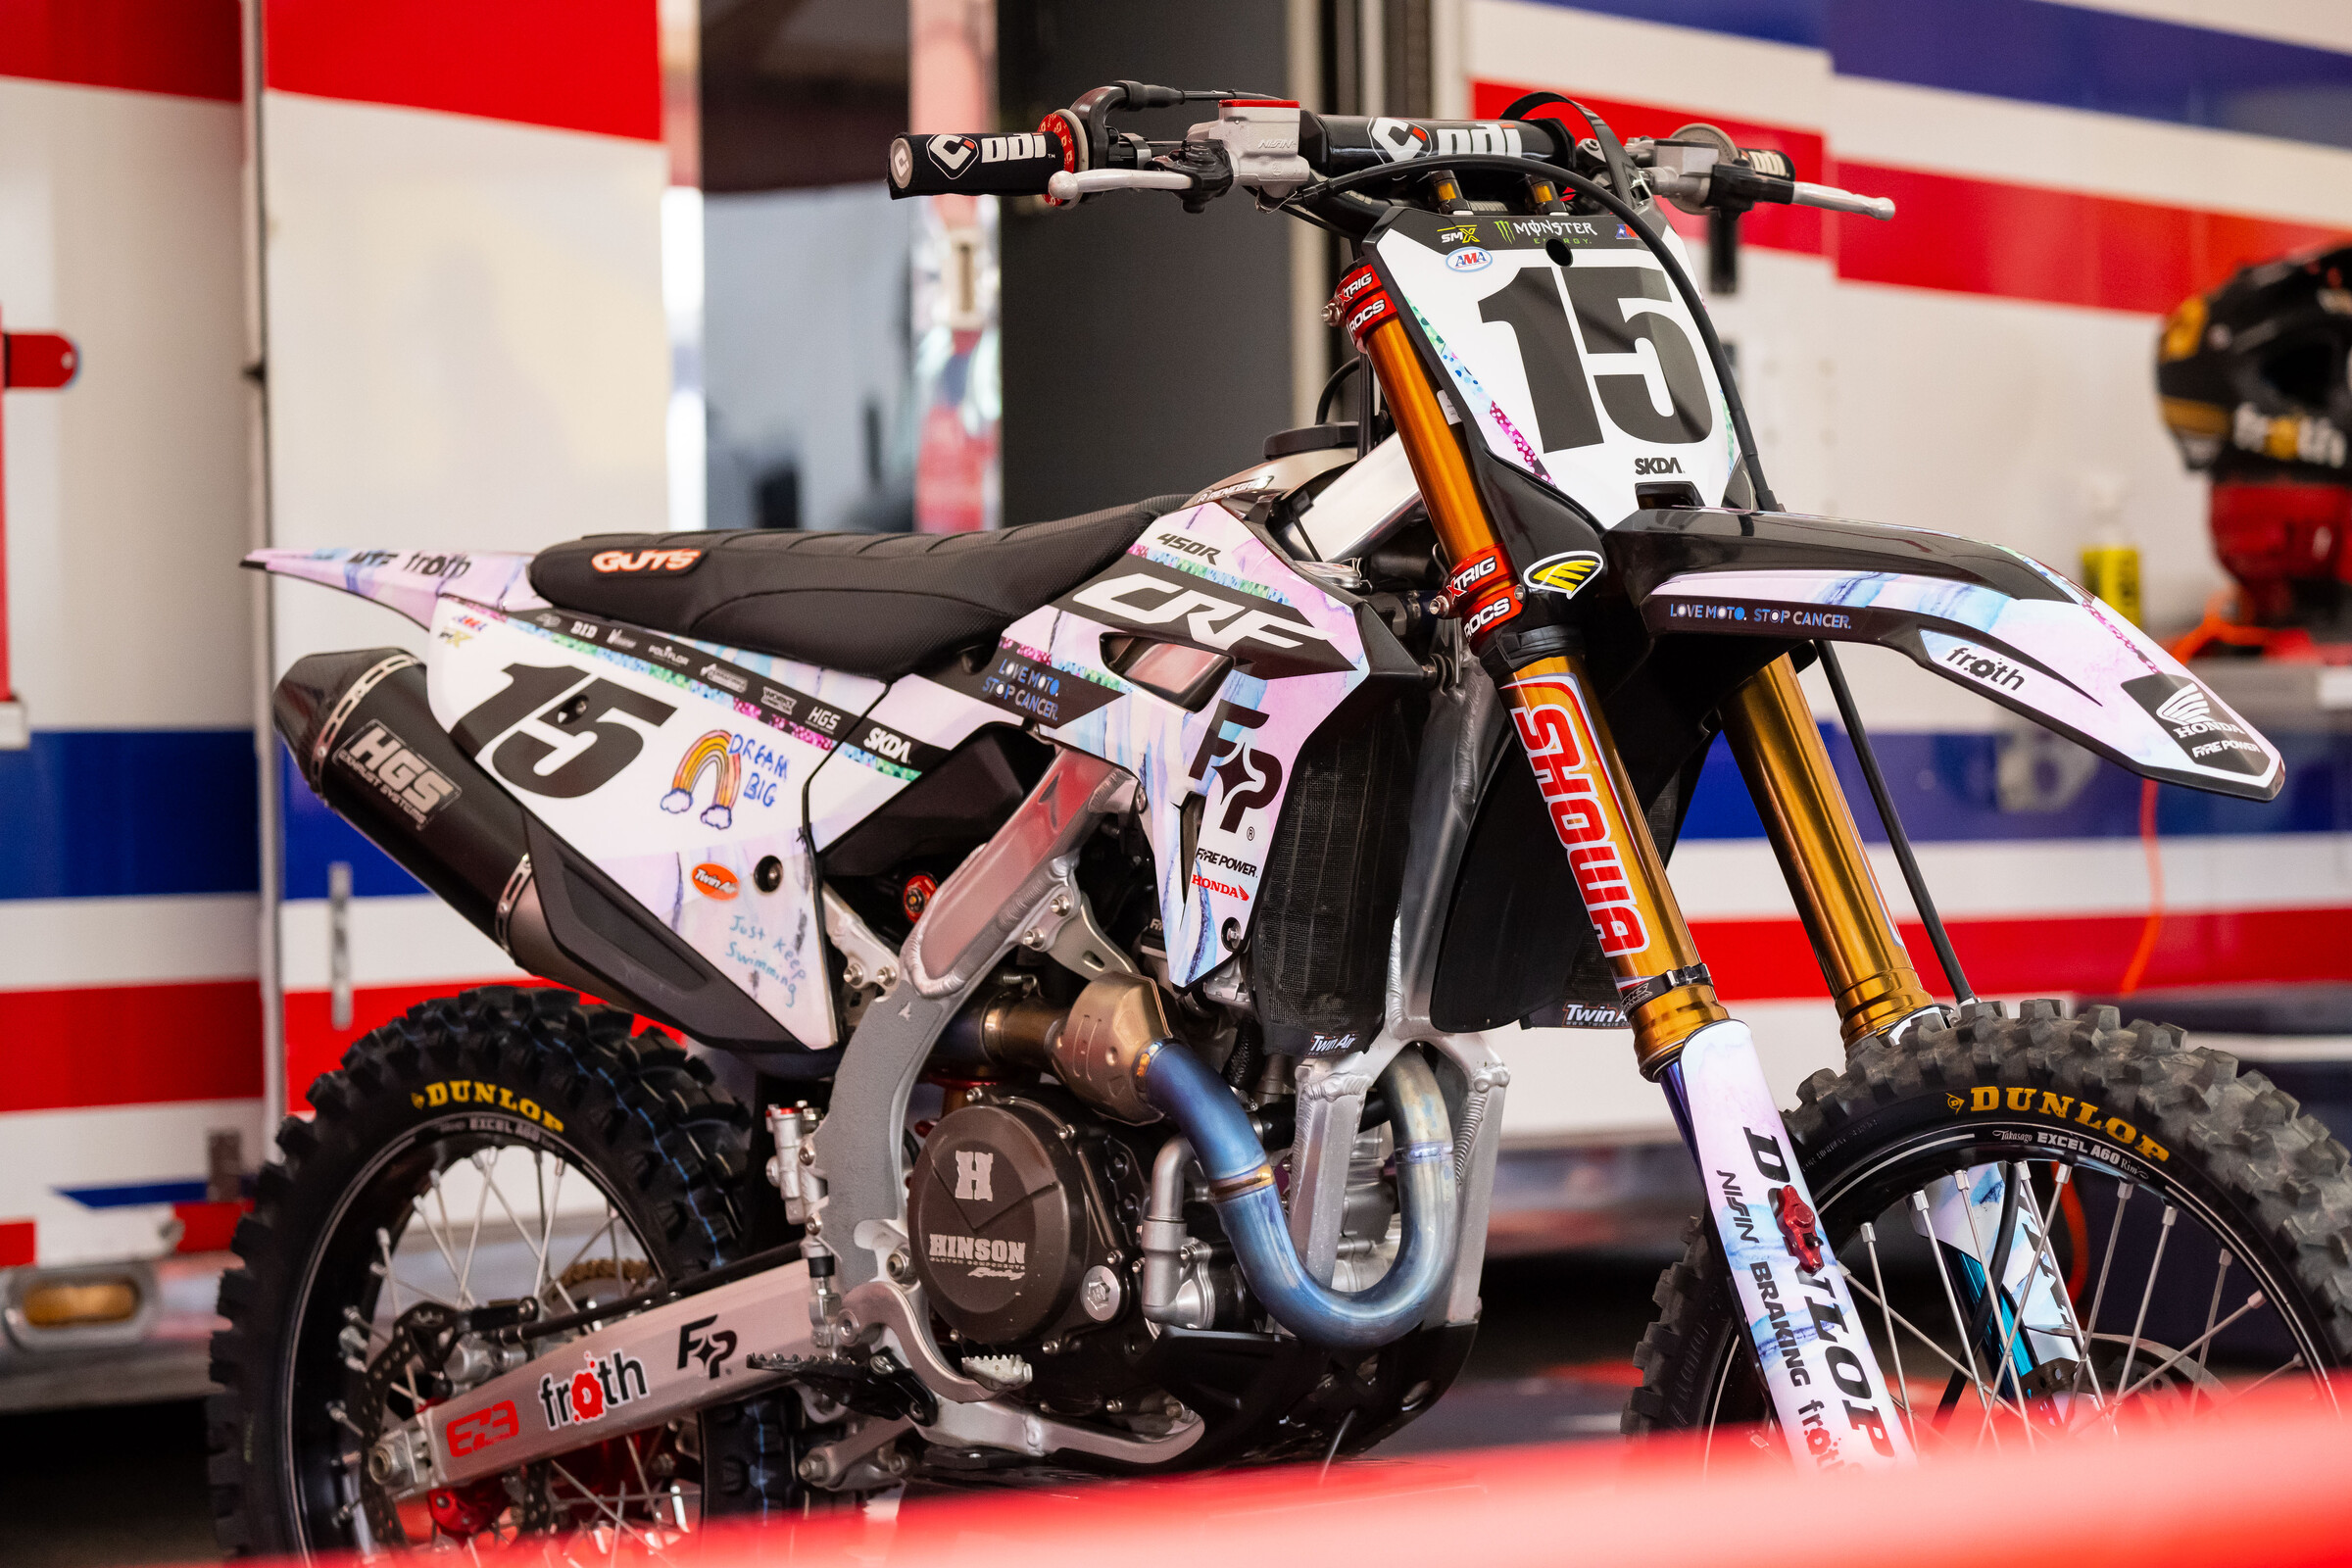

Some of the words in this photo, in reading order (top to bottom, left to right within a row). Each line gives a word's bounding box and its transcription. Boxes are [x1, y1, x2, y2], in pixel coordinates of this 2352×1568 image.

[1454, 252, 1489, 268] AMA
[1337, 272, 1373, 303] XTRIG
[1478, 267, 1712, 454] 15
[1635, 457, 1683, 474] SKDA
[591, 548, 702, 572] GUTS
[1156, 532, 1222, 566] 450R
[1446, 556, 1496, 599] XTRIG
[1072, 572, 1340, 651] CRF
[1463, 597, 1511, 639] ROCS
[1670, 603, 1703, 618] LOVE
[1753, 608, 1791, 624] STOP
[999, 659, 1029, 683] LOVE
[1945, 647, 2025, 692] froth
[982, 676, 1016, 700] STOP
[449, 662, 678, 799] 15
[807, 706, 841, 731] HGS
[2173, 721, 2246, 738] HONDA
[863, 727, 911, 763] SKDA
[349, 726, 454, 814] HGS
[744, 772, 777, 808] BIG
[1509, 703, 1651, 958] SHOWA
[695, 868, 721, 889] Twin
[1192, 874, 1239, 899] HONDA
[1567, 1004, 1612, 1022] Twin
[425, 1080, 564, 1133] DUNLOP
[1970, 1086, 2170, 1162] DUNLOP
[2036, 1131, 2088, 1153] EXCEL
[2090, 1144, 2121, 1165] A60
[955, 1150, 994, 1201] H
[929, 1233, 1026, 1264] HINSON
[1742, 1126, 1895, 1458] DNLOP
[1749, 1261, 1811, 1388] BRAKING
[539, 1348, 649, 1430] froth
